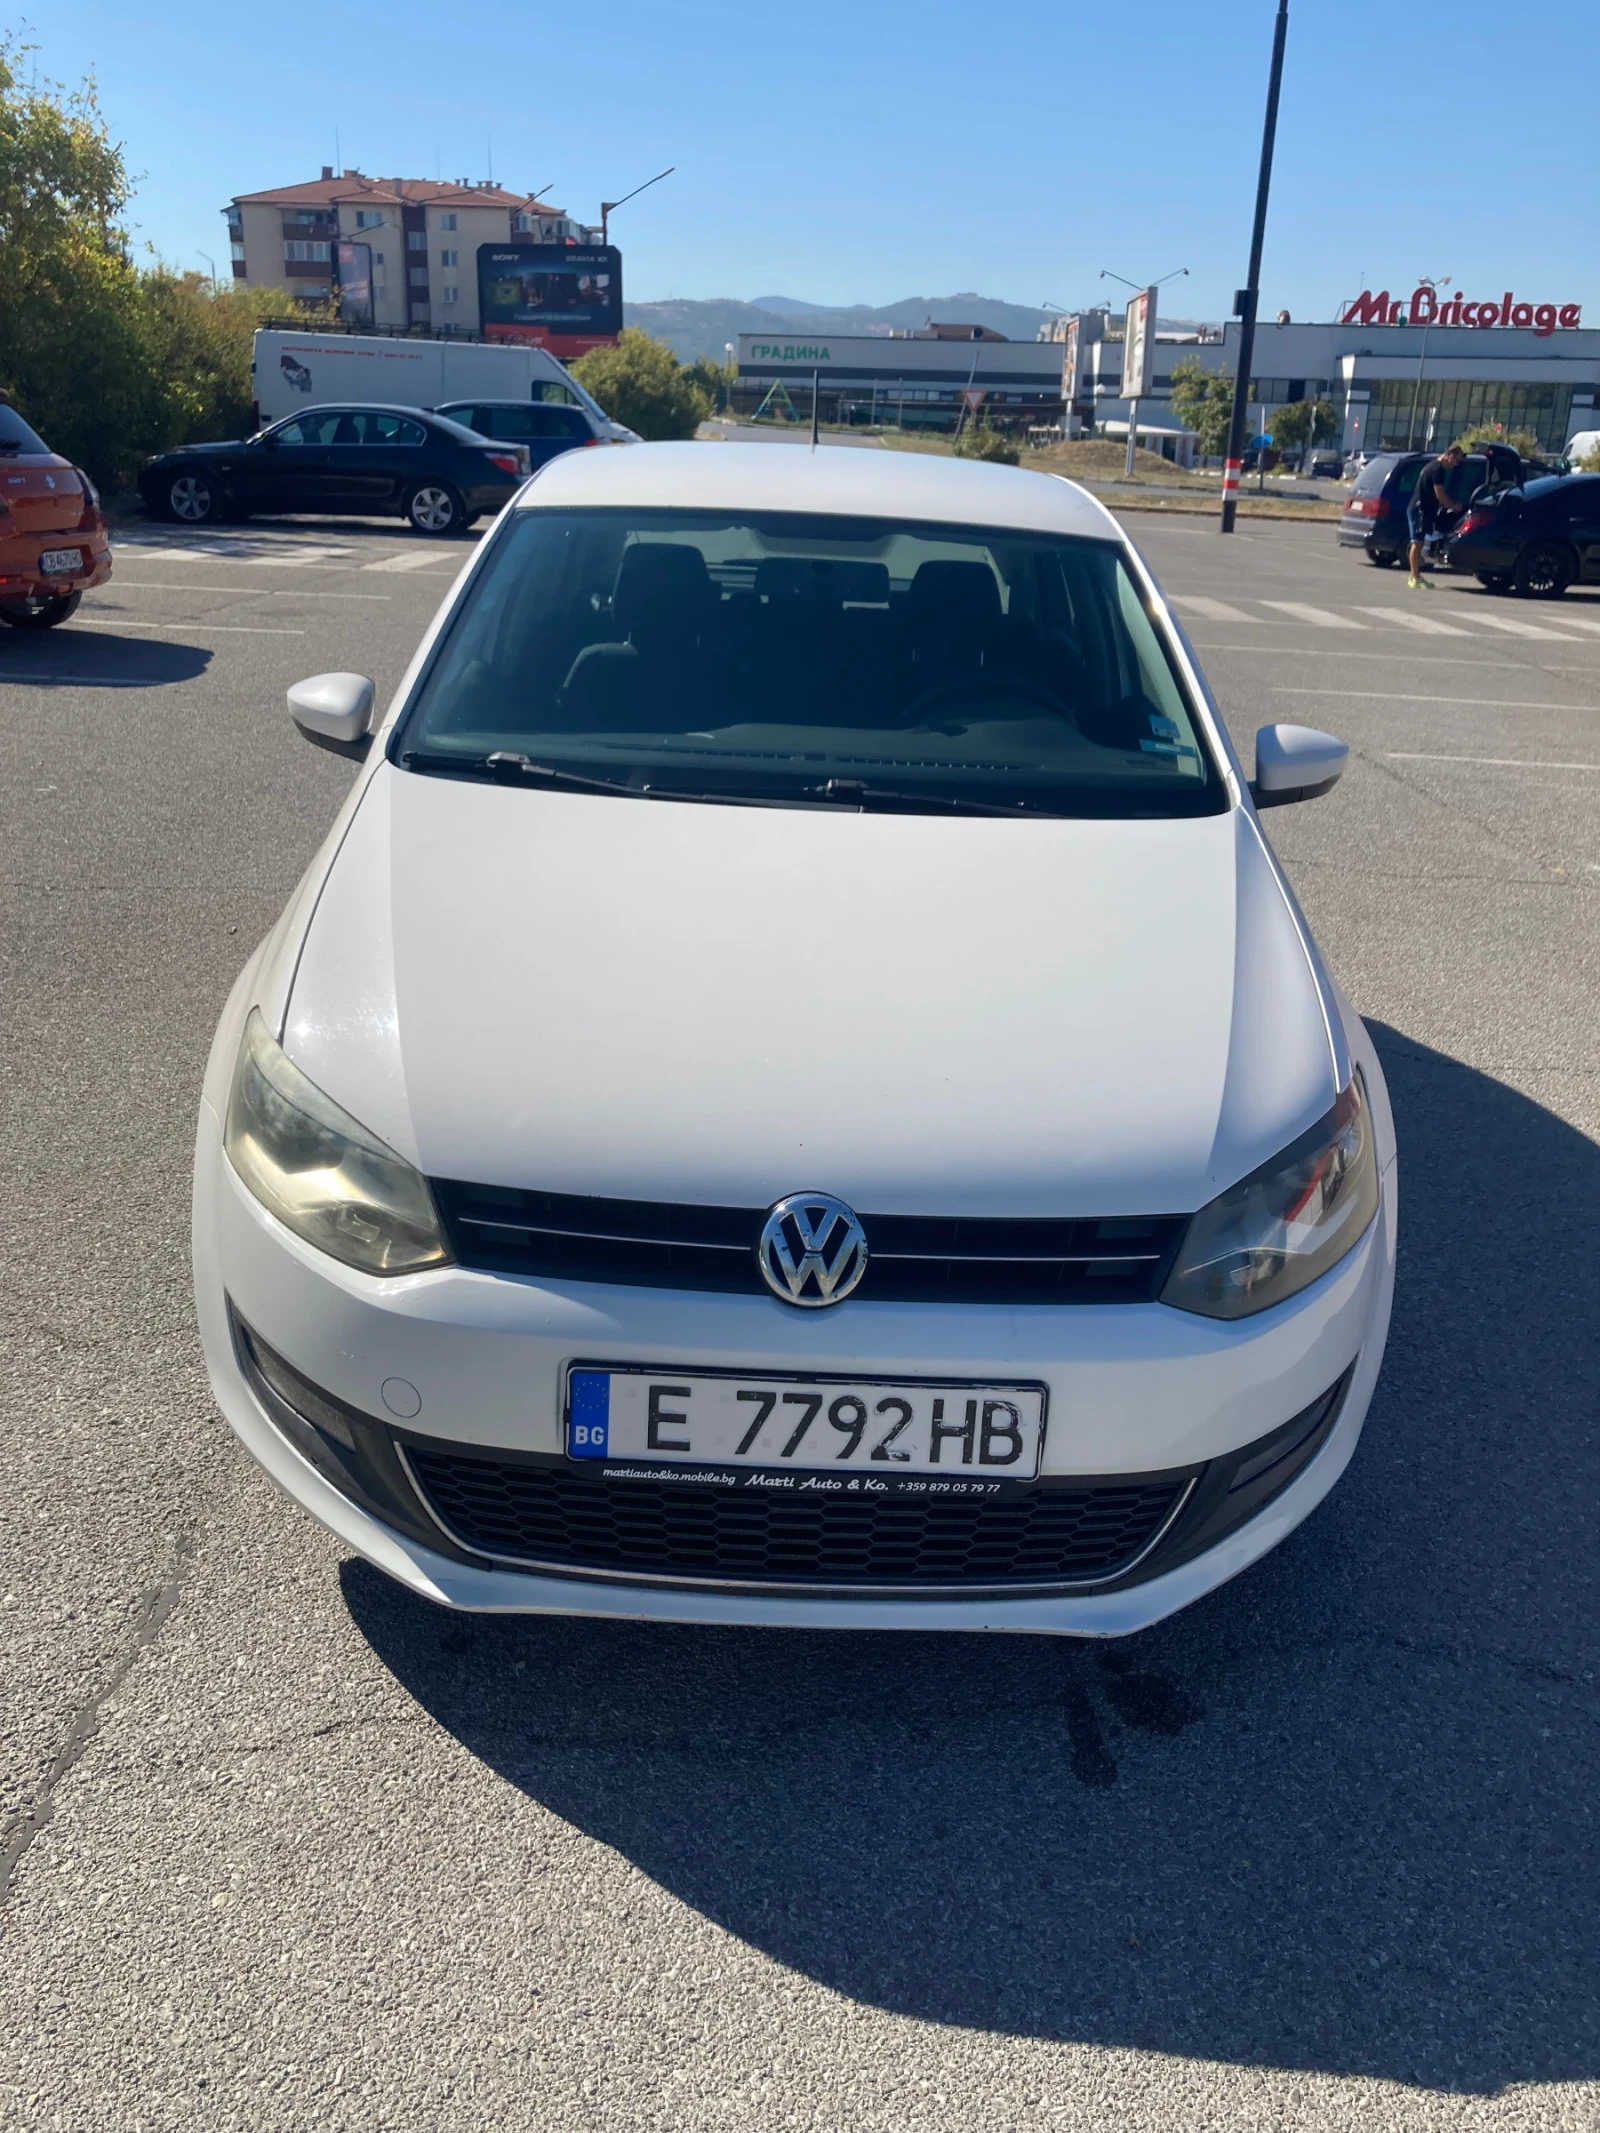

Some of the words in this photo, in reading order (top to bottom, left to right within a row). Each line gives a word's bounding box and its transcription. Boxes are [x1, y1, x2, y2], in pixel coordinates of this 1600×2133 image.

[1409, 287, 1581, 337] Bricolage
[751, 345, 831, 361] ГРАДИНА
[575, 1425, 605, 1445] BG
[647, 1385, 692, 1452] E
[734, 1390, 911, 1462] 7792
[929, 1398, 1024, 1466] HB
[744, 1474, 795, 1487] Marti
[799, 1477, 842, 1490] Auto
[847, 1479, 860, 1490] &
[864, 1479, 889, 1491] Ko.
[897, 1481, 927, 1491] +359
[928, 1482, 950, 1492] 879
[952, 1483, 967, 1492] 05
[970, 1483, 985, 1493] 79
[987, 1484, 1001, 1493] 77
